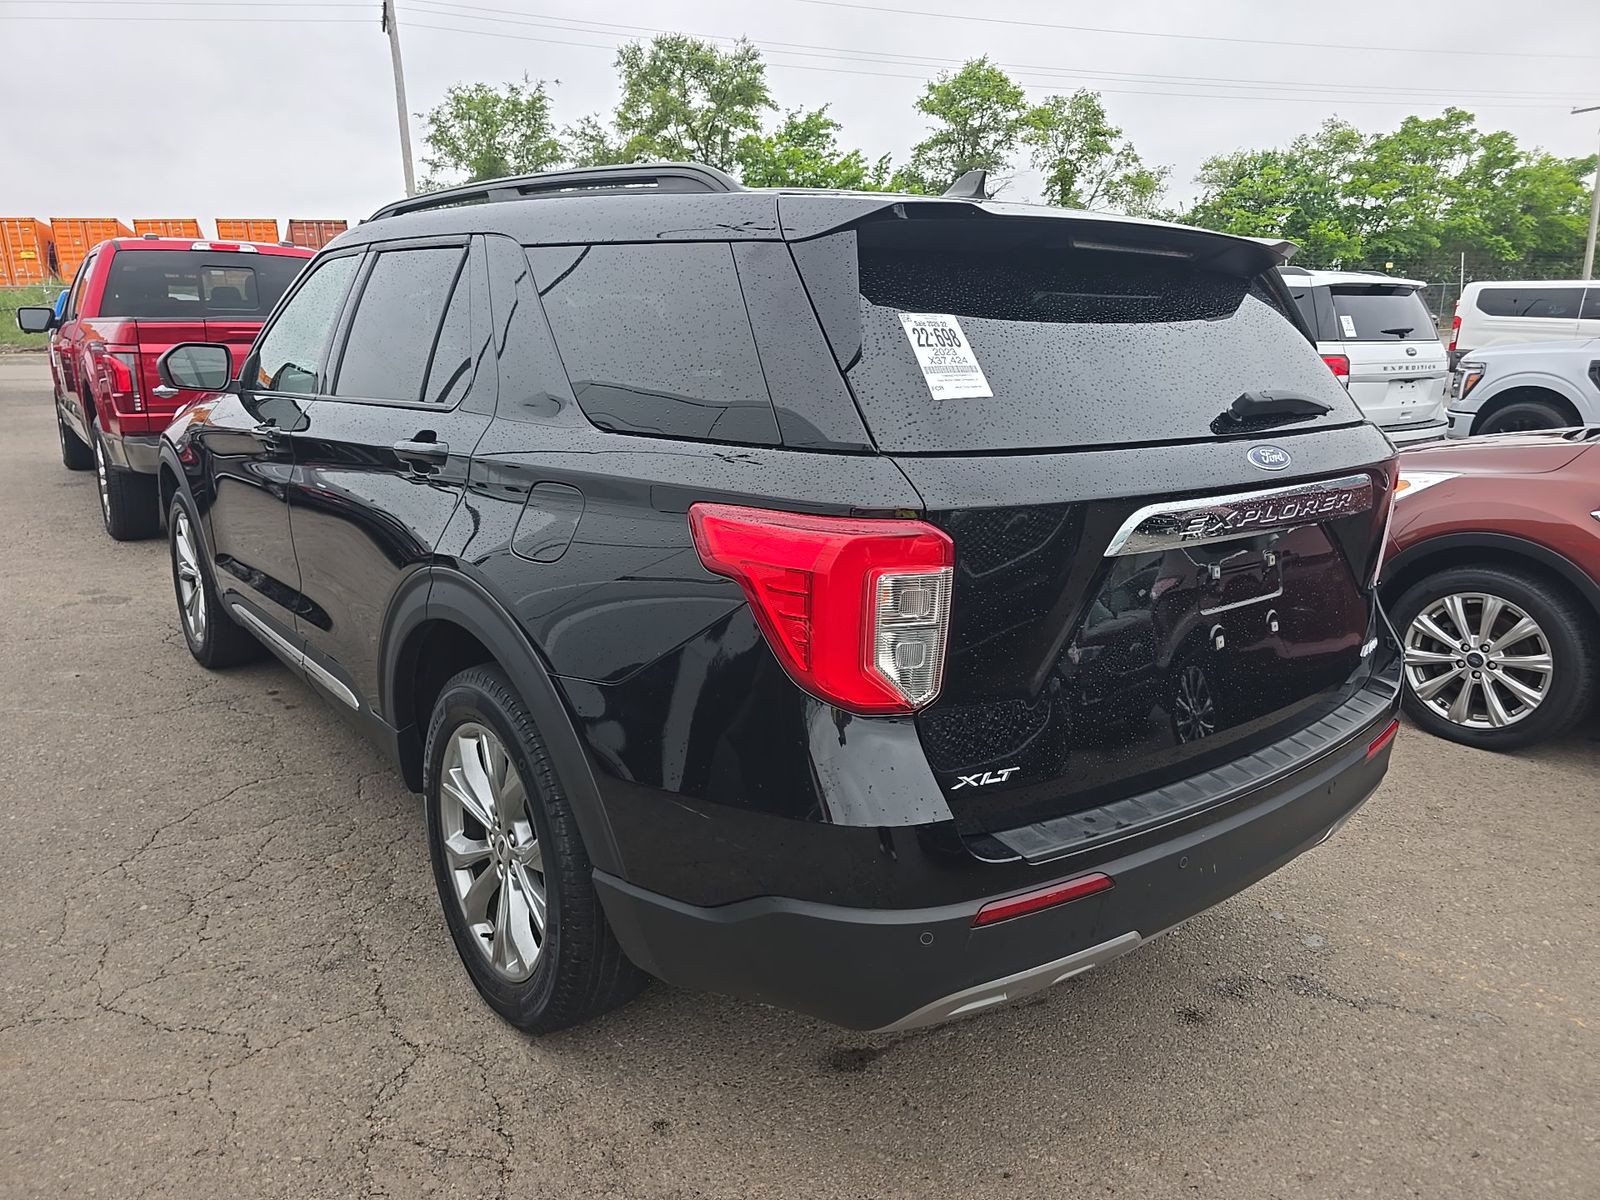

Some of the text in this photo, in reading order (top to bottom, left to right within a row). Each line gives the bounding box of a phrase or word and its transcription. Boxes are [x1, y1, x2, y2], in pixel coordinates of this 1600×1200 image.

[932, 348, 957, 356] 2023
[1259, 448, 1286, 464] Ford
[1179, 494, 1353, 536] EXPLORER
[950, 766, 1021, 790] XLT
